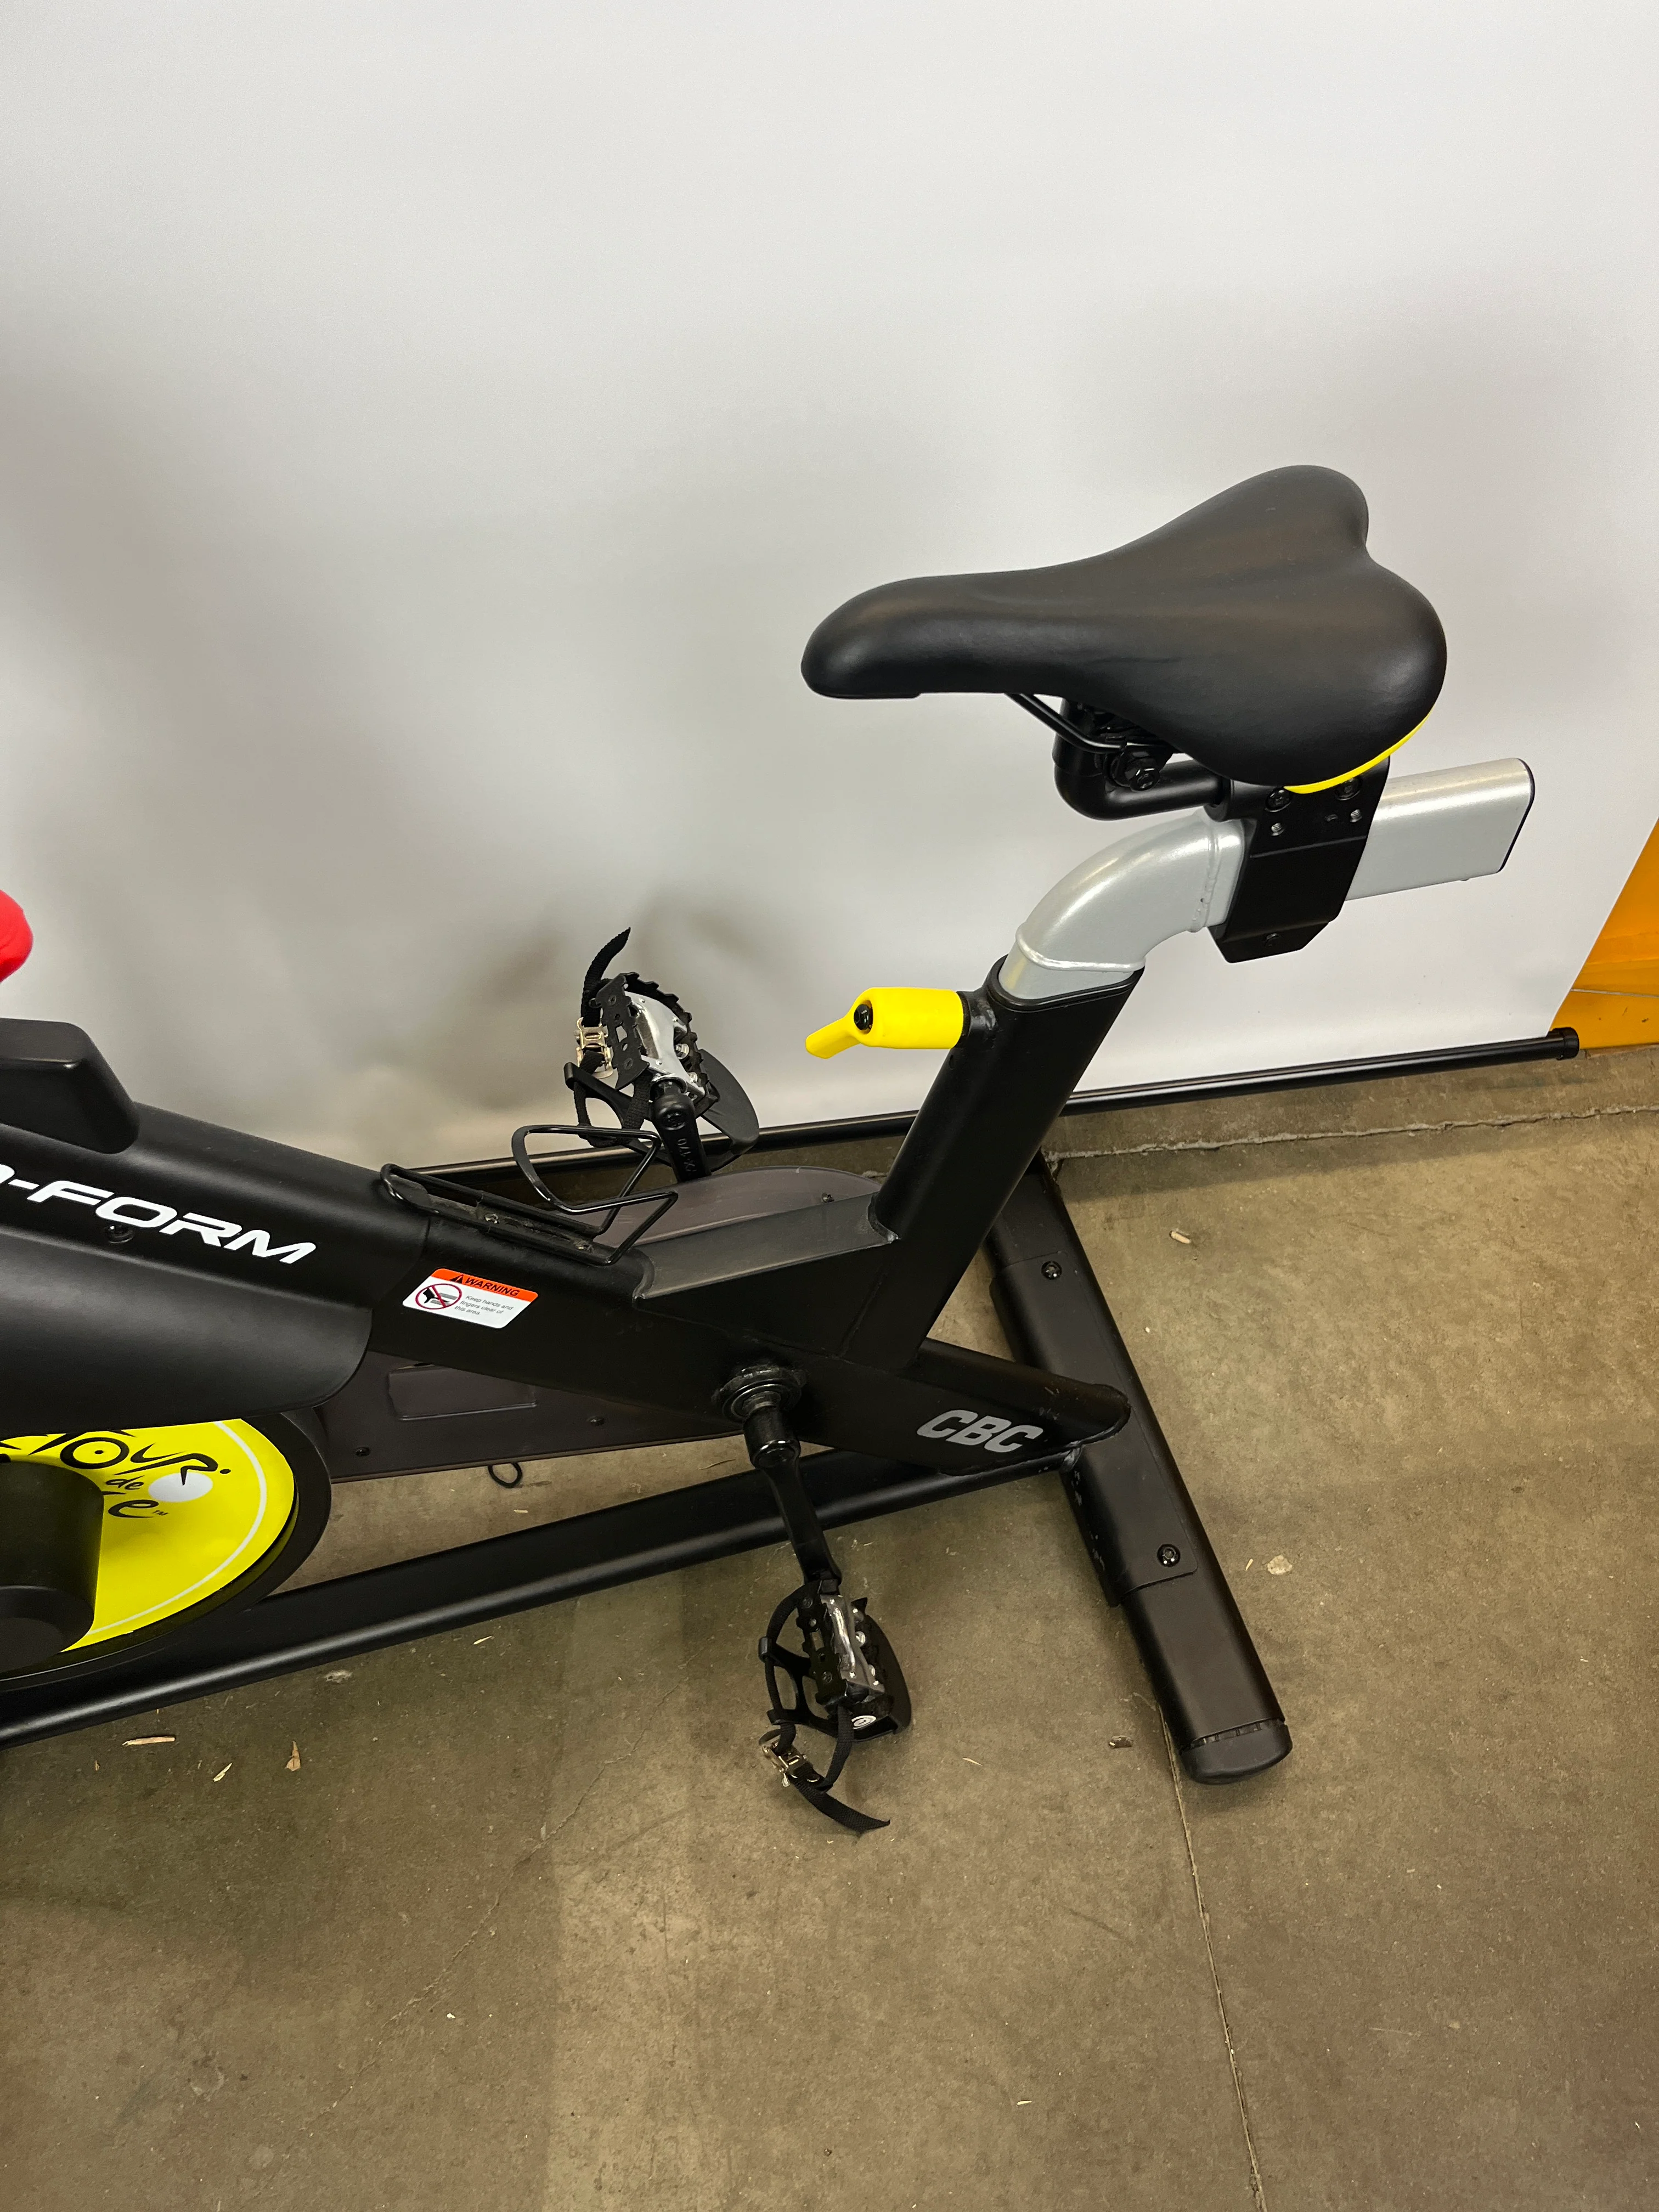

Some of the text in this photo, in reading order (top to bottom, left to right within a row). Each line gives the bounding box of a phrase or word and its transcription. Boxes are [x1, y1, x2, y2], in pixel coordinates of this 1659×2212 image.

[0, 1164, 317, 1264] -FORM
[465, 1277, 520, 1296] WARNING
[460, 1300, 481, 1308] fingers
[917, 1409, 1043, 1453] CBC
[105, 1475, 145, 1490] de
